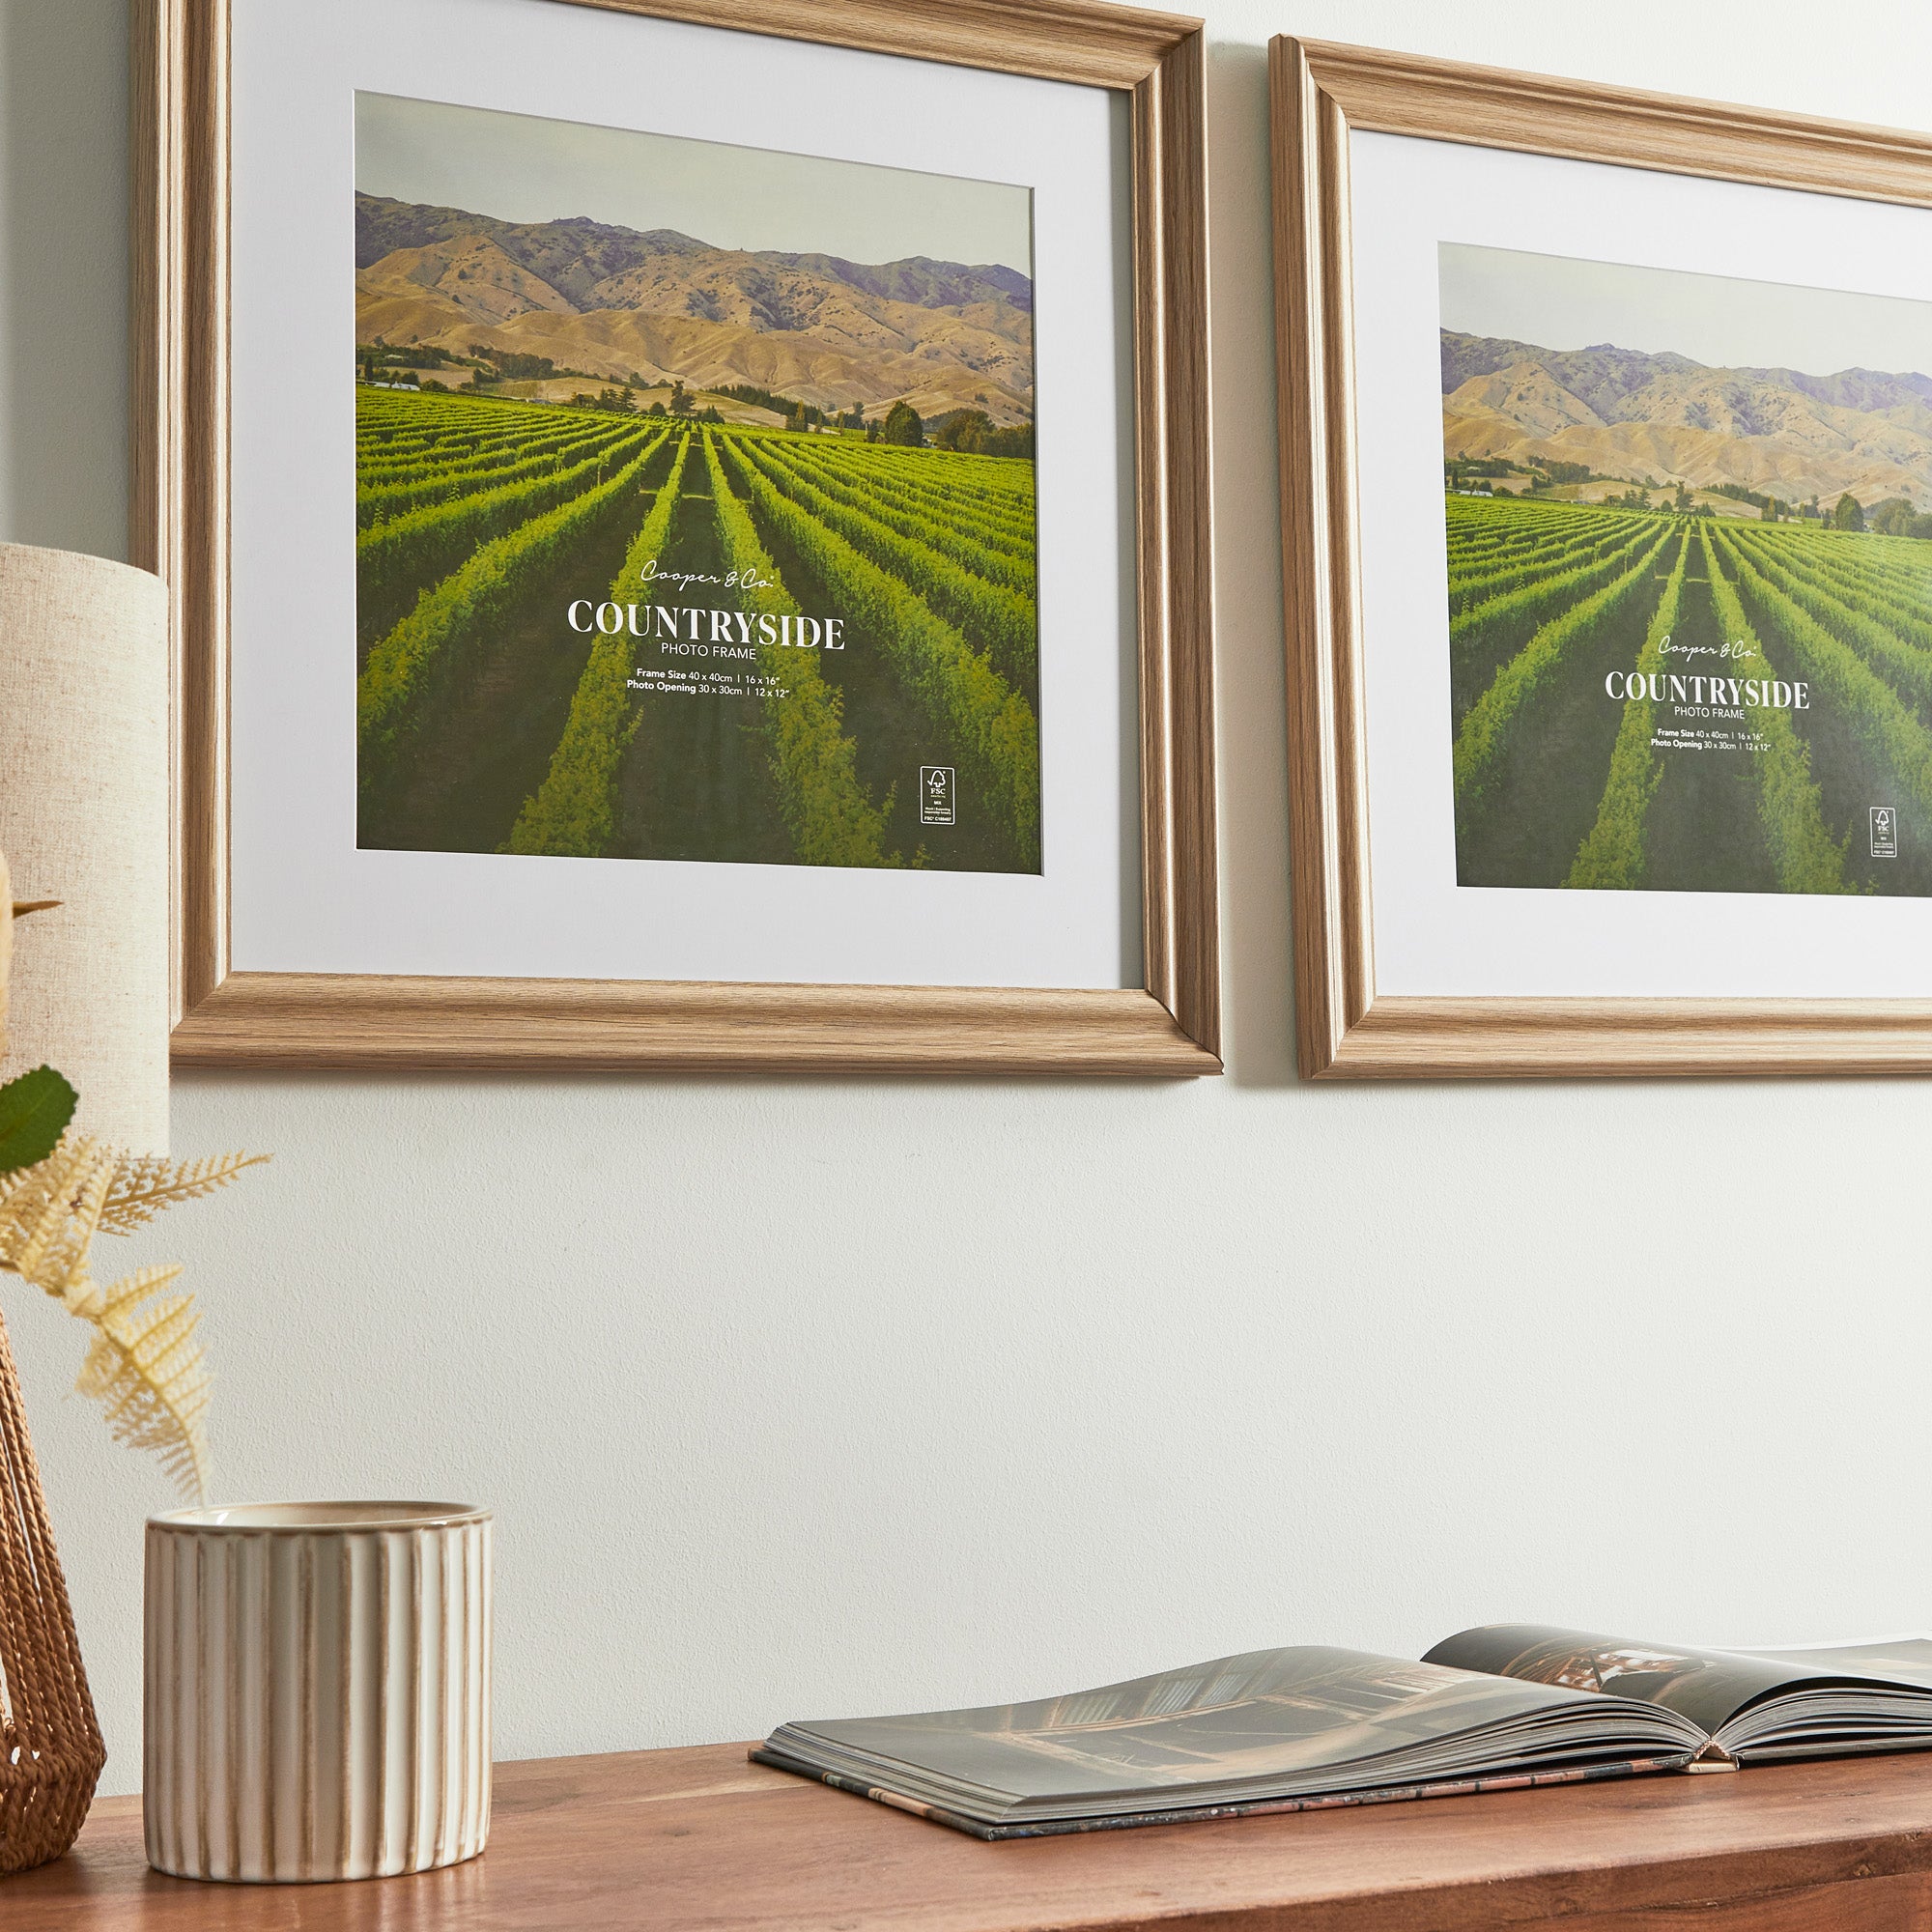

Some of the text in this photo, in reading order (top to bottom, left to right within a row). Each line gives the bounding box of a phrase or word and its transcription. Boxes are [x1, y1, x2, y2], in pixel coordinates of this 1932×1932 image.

[640, 560, 721, 591] Cooper
[724, 572, 739, 587] &
[567, 600, 845, 650] COUNTRYSIDE
[661, 643, 755, 659] PHOTO FRAME
[1659, 636, 1718, 662] Cooper
[1719, 643, 1731, 657] &
[637, 668, 666, 679] Frame
[668, 670, 686, 680] Size
[709, 673, 732, 682] 40cm
[746, 675, 755, 684] 16
[627, 680, 654, 690] Photo
[657, 682, 696, 695] Opening
[698, 685, 710, 694] 30
[719, 686, 742, 695] 30cm
[755, 688, 765, 696] 12
[1605, 671, 1810, 709] COUNTRYSIDE
[1674, 706, 1745, 719] PHOTO FRAME
[1658, 728, 1679, 737] Frame
[1673, 740, 1702, 750] Opening
